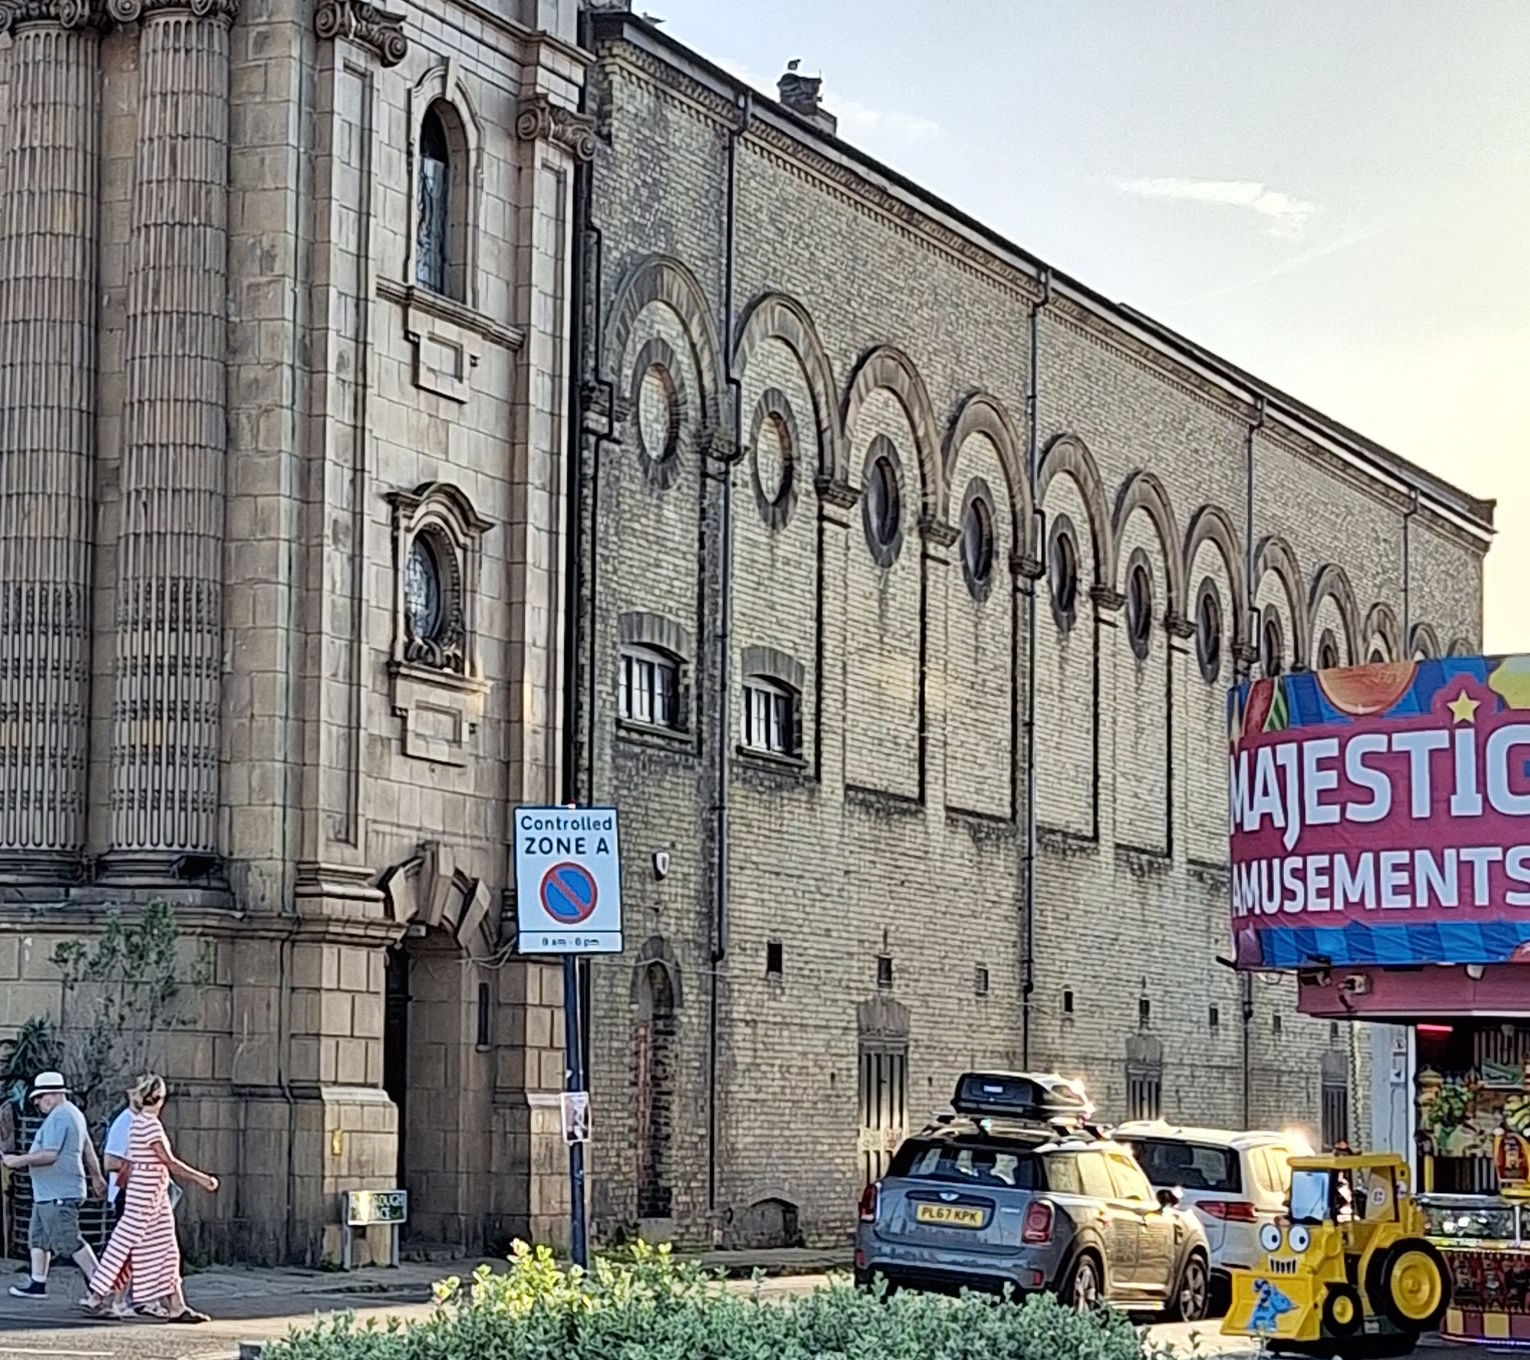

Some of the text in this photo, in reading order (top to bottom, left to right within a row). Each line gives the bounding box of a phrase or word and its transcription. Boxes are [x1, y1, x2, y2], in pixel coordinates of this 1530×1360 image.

[1229, 723, 1530, 852] MAJESTIC
[520, 815, 613, 831] Controlled
[524, 837, 610, 855] ZONE A
[1232, 845, 1530, 918] AMUSEMENTS
[921, 1207, 979, 1223] PL67 KPK
